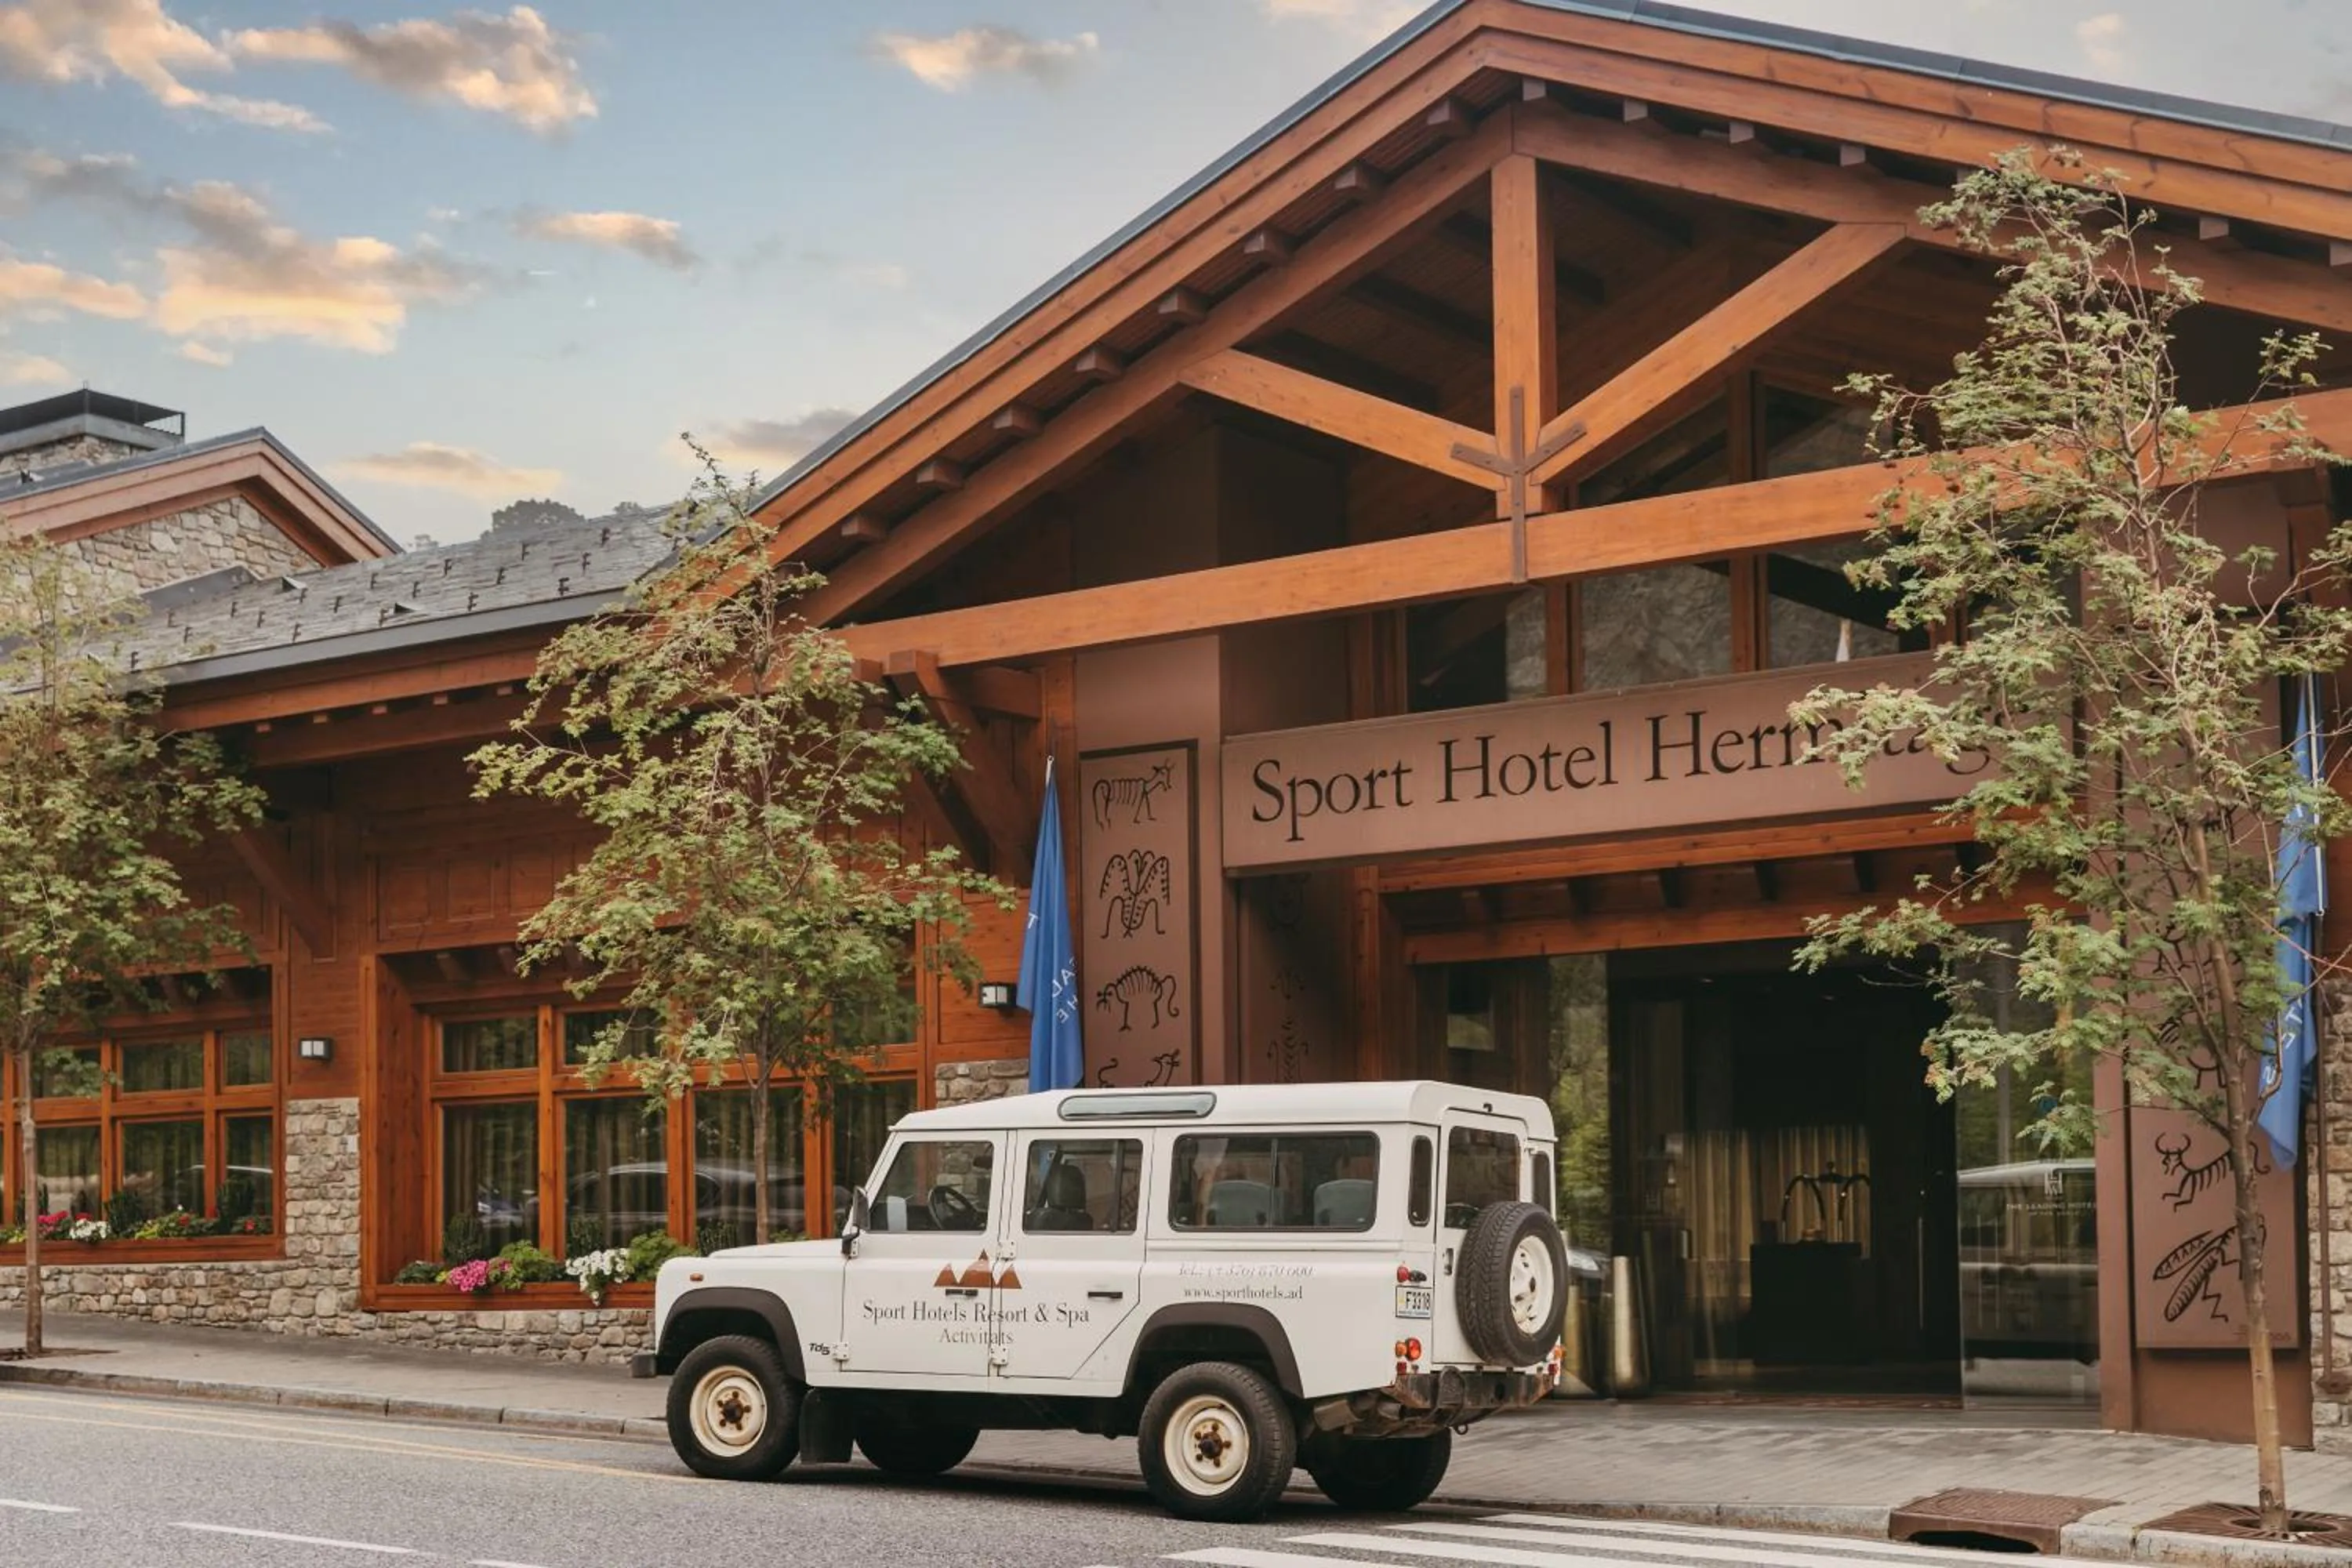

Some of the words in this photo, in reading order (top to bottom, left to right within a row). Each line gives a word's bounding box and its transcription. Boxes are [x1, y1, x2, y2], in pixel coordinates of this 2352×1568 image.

[1252, 759, 1414, 842] Sport
[1437, 720, 1619, 804] Hotel
[1182, 1284, 1303, 1303] www.sporthotels.ad
[862, 1300, 905, 1326] Sport
[912, 1301, 967, 1322] Hotels
[974, 1301, 1028, 1323] Resort
[1034, 1303, 1050, 1323] &
[1055, 1301, 1090, 1328] Spa
[938, 1327, 1014, 1345] Activitats
